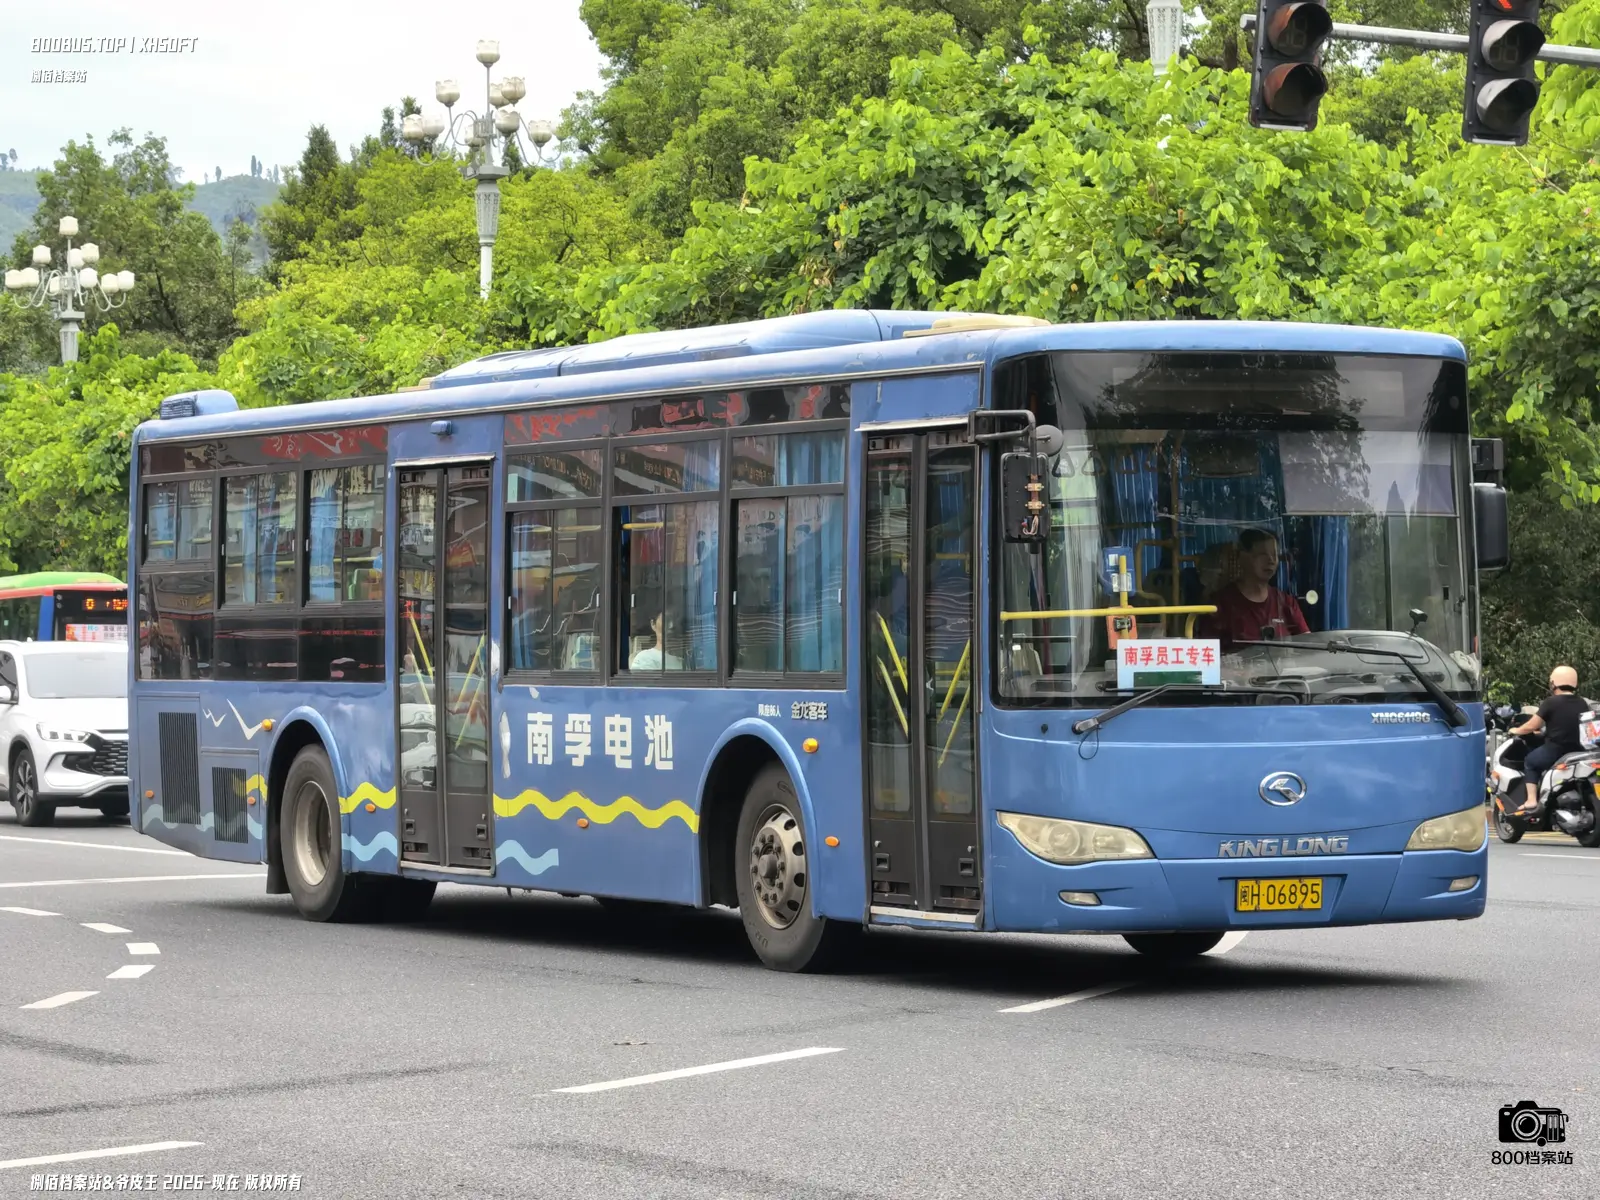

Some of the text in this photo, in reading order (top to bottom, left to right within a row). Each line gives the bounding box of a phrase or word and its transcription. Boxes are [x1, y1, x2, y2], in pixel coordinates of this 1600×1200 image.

[1123, 645, 1215, 666] 南孚员工专车
[791, 701, 829, 721] 金龙客车
[1370, 711, 1431, 724] XMQ6119G
[526, 711, 674, 771] 南孚电池
